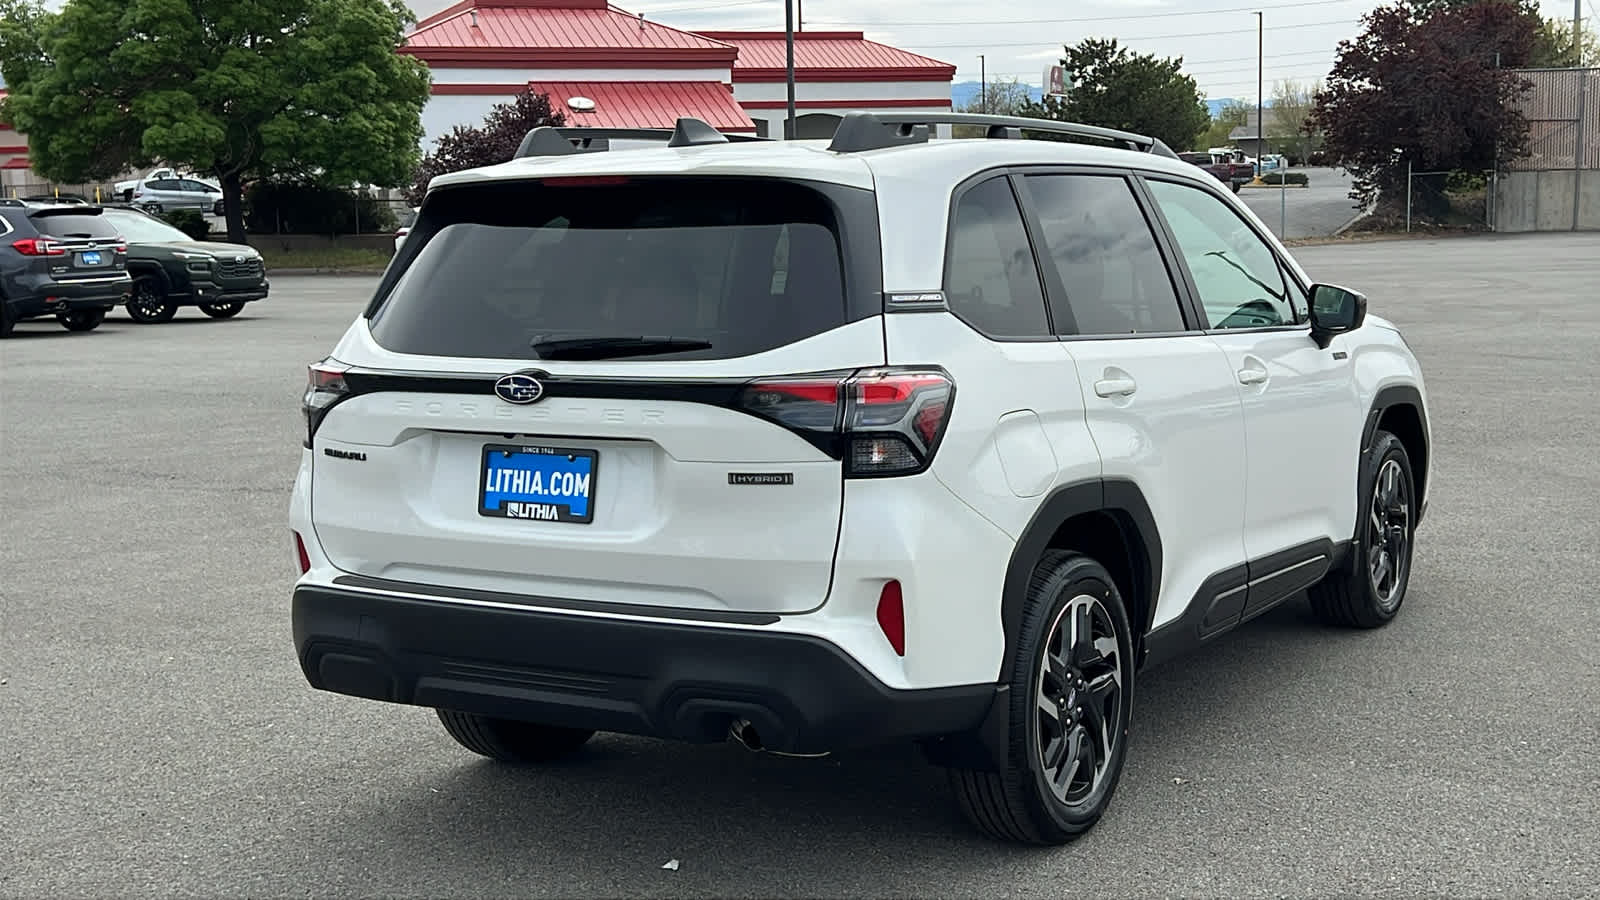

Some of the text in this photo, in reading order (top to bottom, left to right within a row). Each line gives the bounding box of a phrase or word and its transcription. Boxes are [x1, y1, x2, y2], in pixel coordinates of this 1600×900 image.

[395, 400, 665, 424] FORESTER
[324, 447, 367, 461] SUBARU
[522, 446, 540, 454] SINCE
[485, 468, 590, 497] LITHIA.COM
[736, 474, 783, 483] HYBRID
[518, 502, 559, 520] LITHIA
